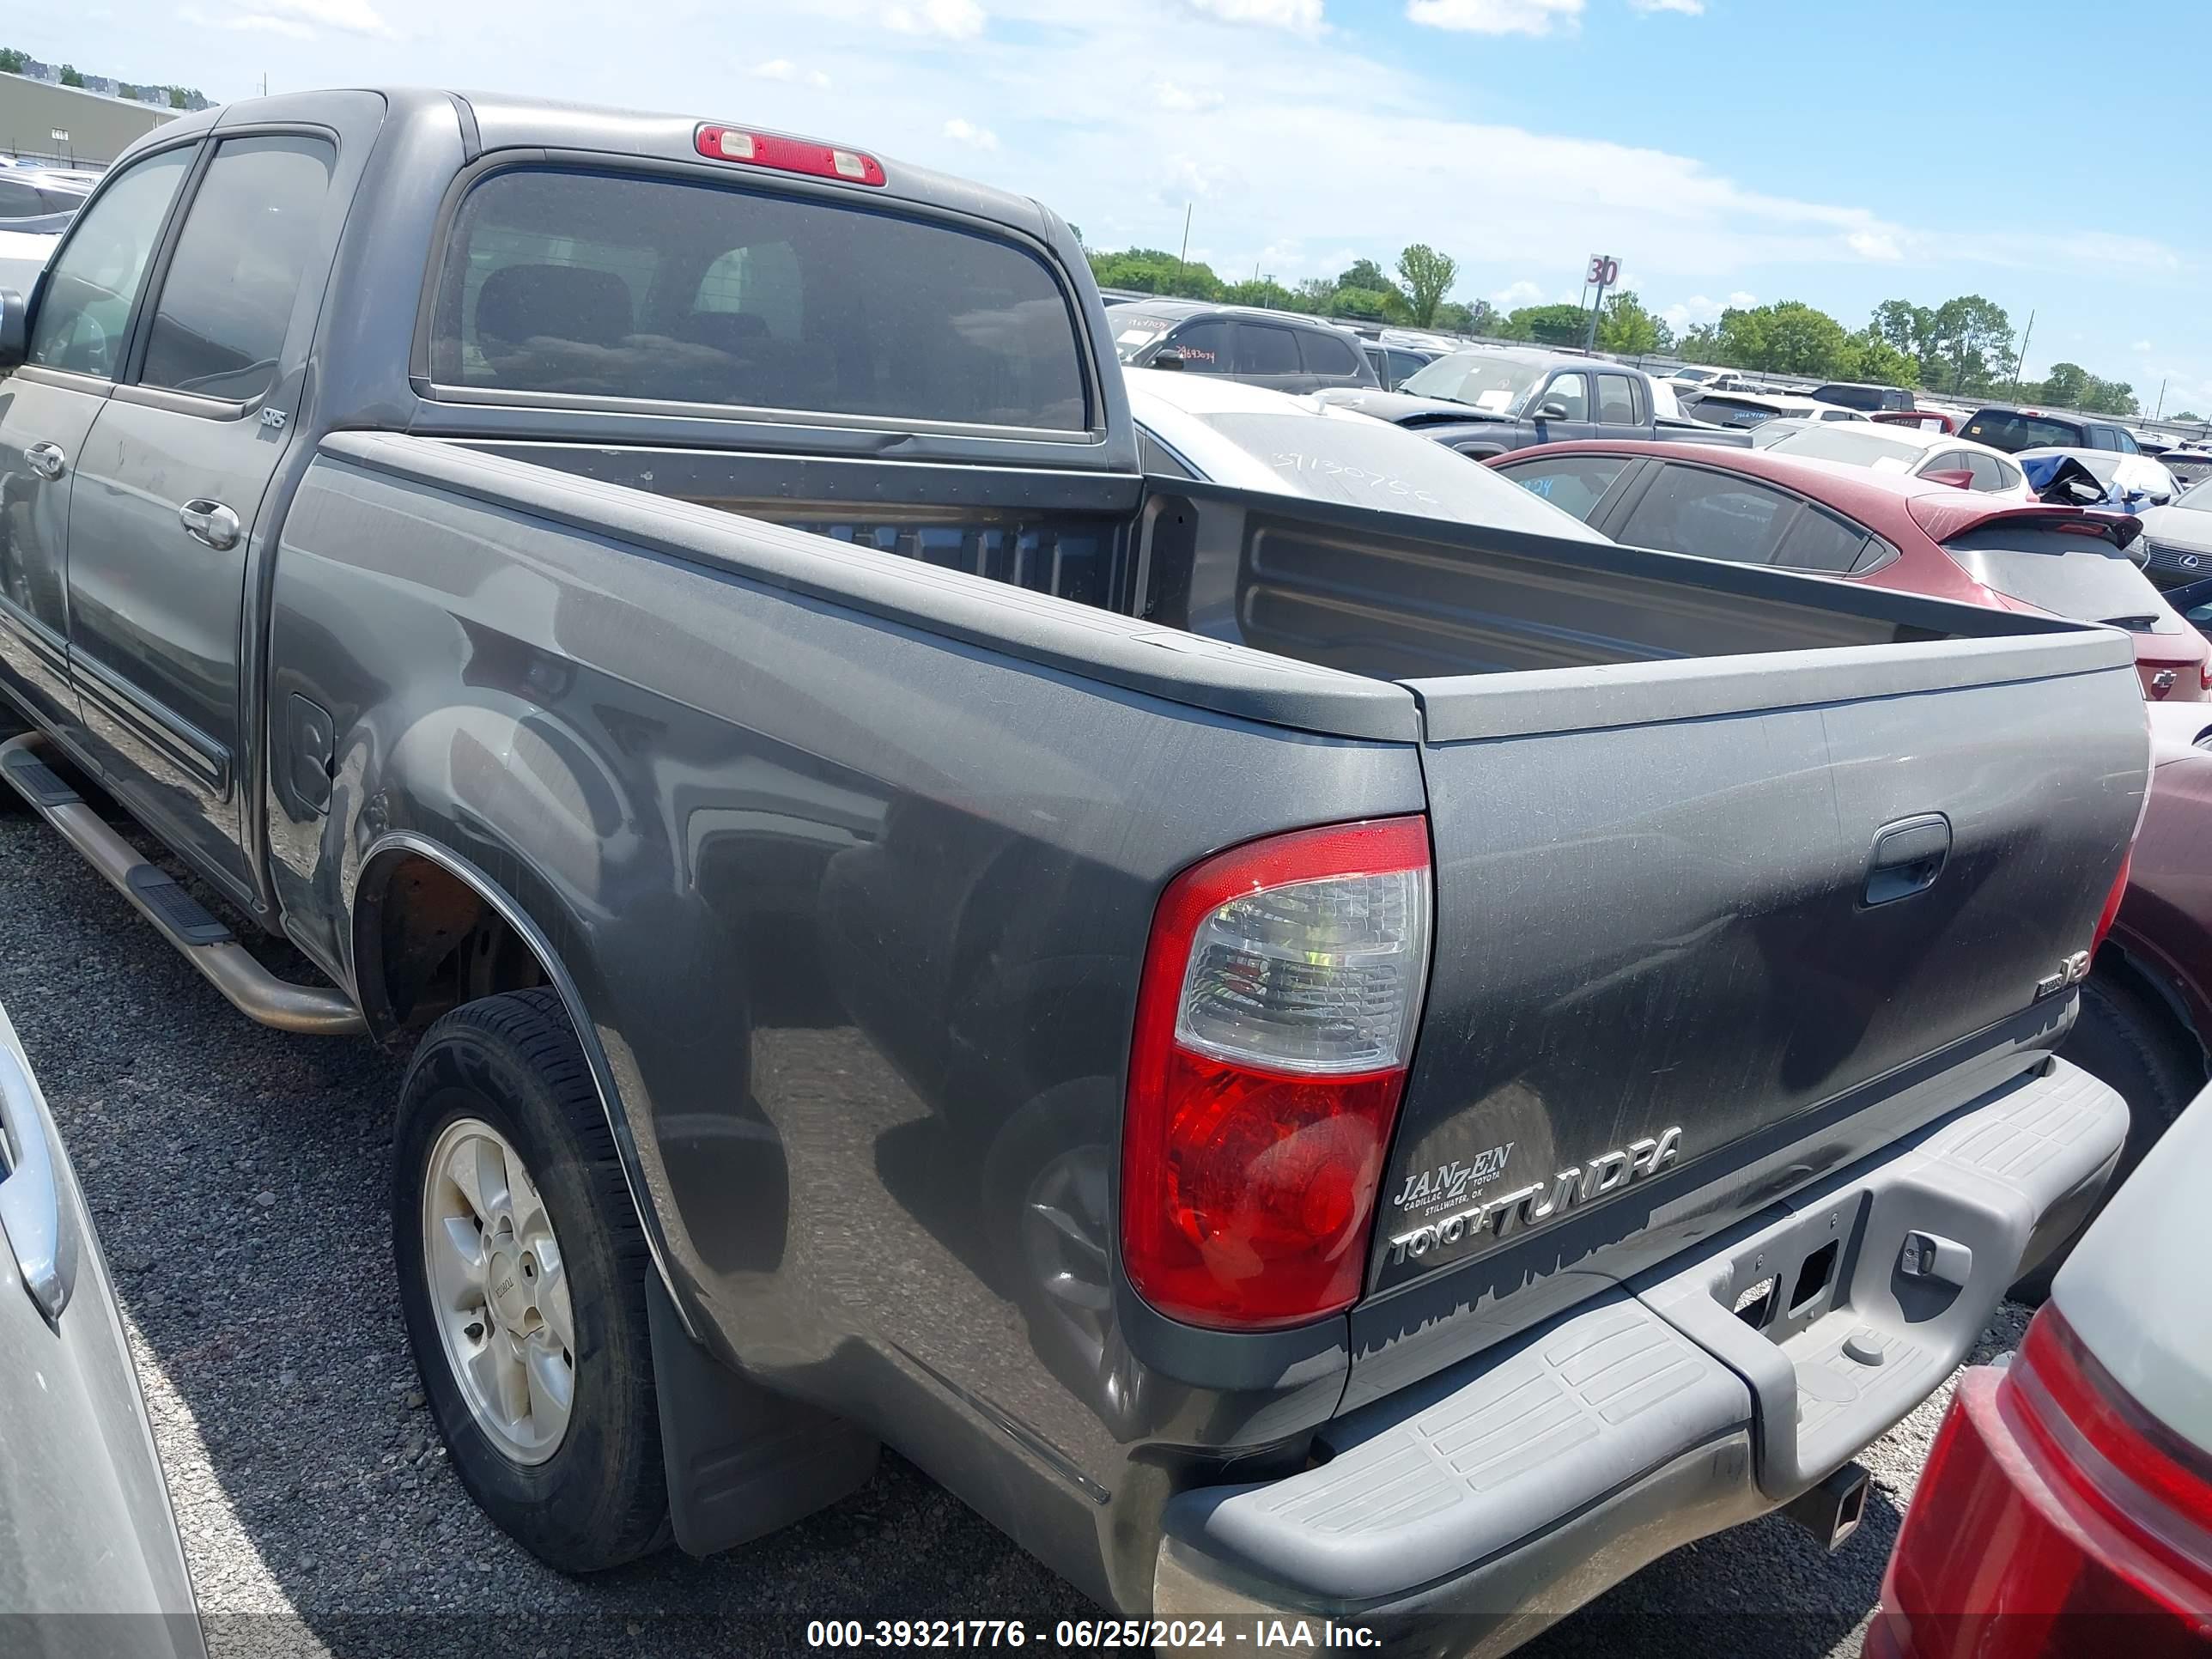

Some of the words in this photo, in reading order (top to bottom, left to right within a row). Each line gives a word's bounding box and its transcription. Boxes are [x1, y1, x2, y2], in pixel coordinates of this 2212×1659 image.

[1589, 258, 1618, 285] 30
[1394, 1141, 1515, 1206] JANZEN
[1403, 1191, 1443, 1212] CADILLAC
[1473, 1170, 1500, 1187] TOYOTA
[1389, 1203, 1493, 1266] TOYOTA
[1492, 1127, 1682, 1237] TUNDRA
[1424, 1194, 1469, 1217] STILLWATER,
[1471, 1188, 1484, 1199] OK
